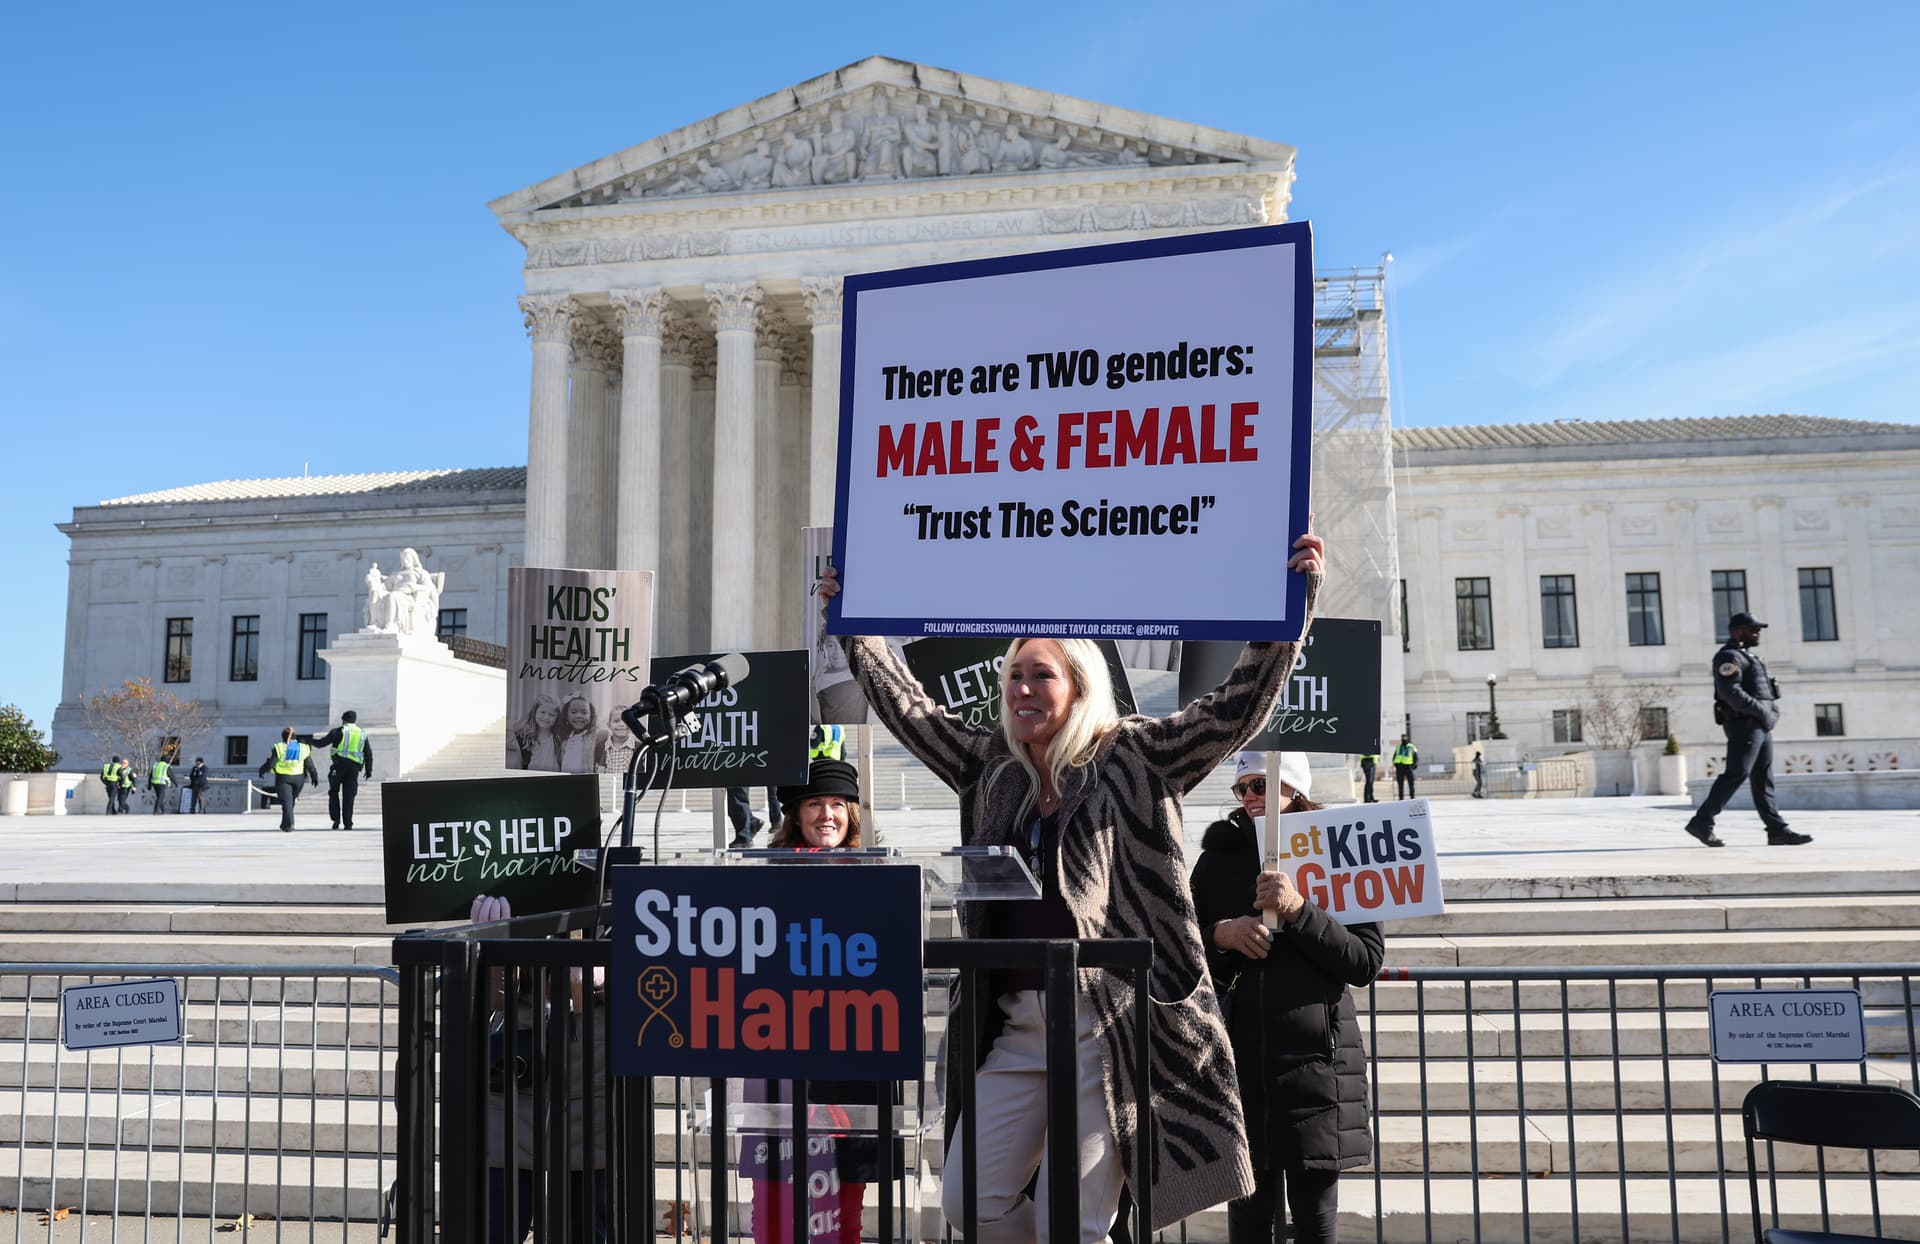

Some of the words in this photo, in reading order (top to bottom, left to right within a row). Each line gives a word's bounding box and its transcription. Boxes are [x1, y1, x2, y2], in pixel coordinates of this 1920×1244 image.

[906, 220, 973, 240] UNDER
[983, 217, 1023, 235] LAW
[882, 365, 963, 400] There
[970, 362, 1020, 394] are
[1026, 349, 1099, 390] TWO
[1106, 342, 1254, 390] genders:
[876, 417, 1000, 478] MALE
[1009, 415, 1045, 472] &
[1056, 401, 1259, 470] FEMALE
[903, 503, 992, 540] “Trust
[999, 502, 1054, 538] The
[1060, 495, 1216, 537] Science!”
[547, 585, 616, 622] KIDS’
[530, 625, 630, 662] HEALTH
[924, 623, 955, 634] FOLLOW
[955, 623, 1027, 635] CONGRESSWOMAN
[1027, 623, 1067, 635] MARJORIE
[1068, 624, 1100, 635] TAYLOR
[1100, 624, 1135, 636] GREENE:
[1136, 624, 1179, 636] @REPMTG
[519, 656, 641, 685] matters
[661, 742, 768, 771] matters
[412, 820, 492, 859] LET’S
[500, 816, 572, 855] HELP
[1326, 820, 1422, 869] Kids
[406, 847, 473, 883] not
[480, 847, 582, 880] harm
[1296, 862, 1425, 913] Grow
[635, 889, 777, 974] Stop
[786, 918, 878, 977] the
[76, 996, 110, 1010] AREA
[116, 991, 165, 1007] CLOSED
[690, 967, 900, 1052] Harm
[1730, 1003, 1775, 1017] AREA
[1782, 1002, 1846, 1017] CLOSED
